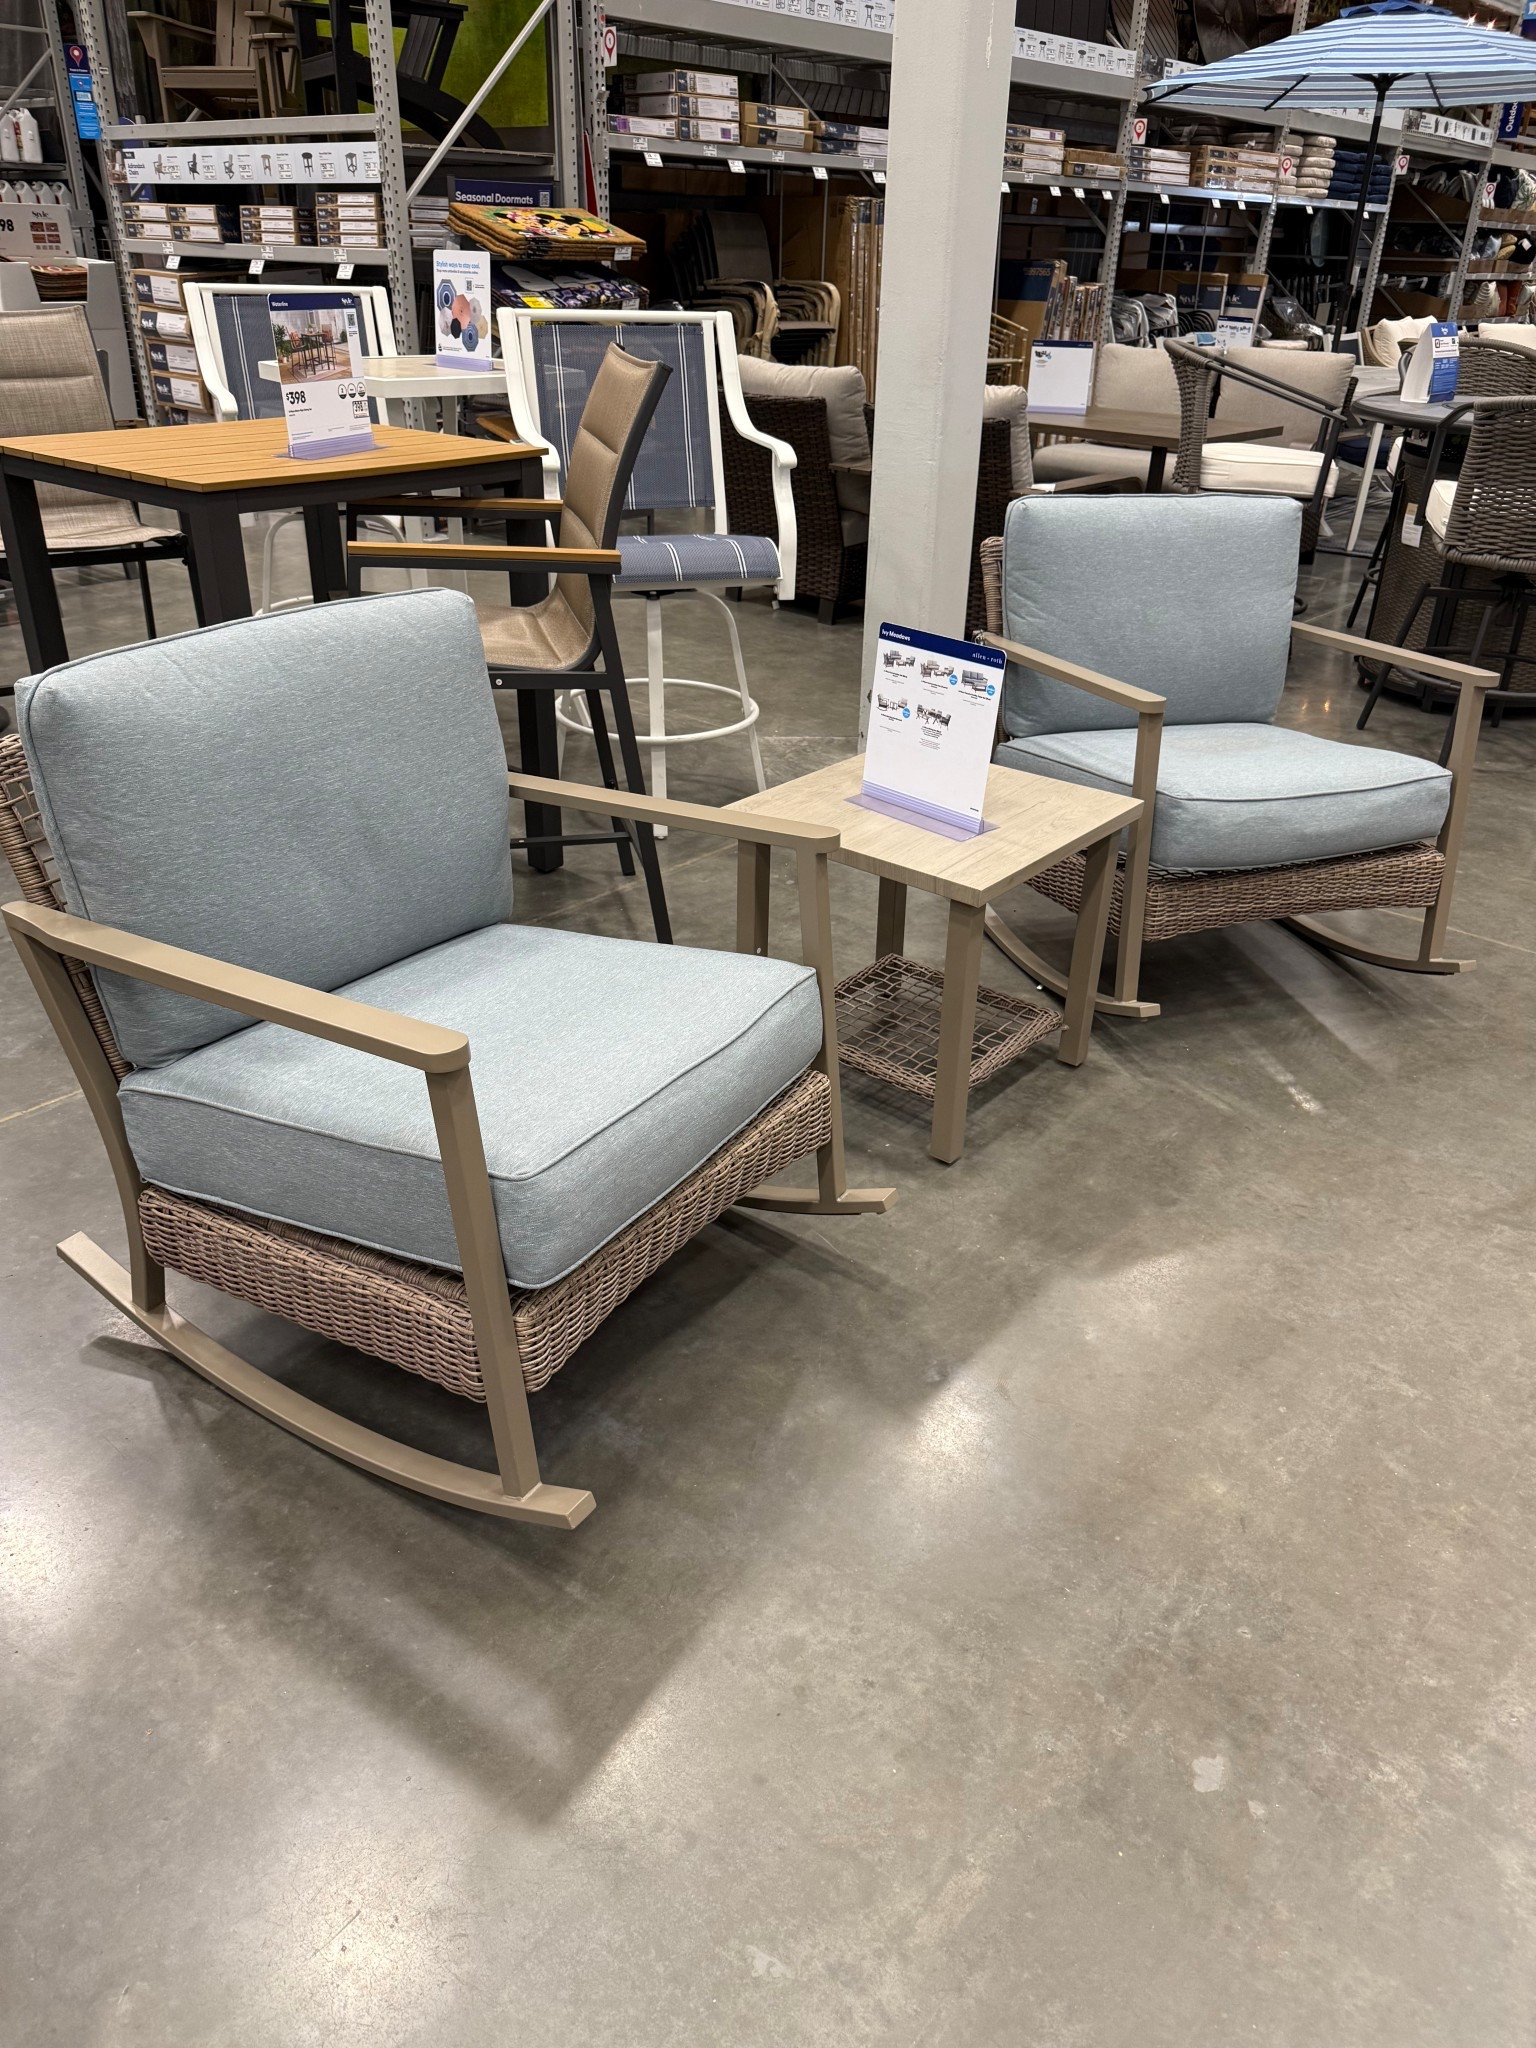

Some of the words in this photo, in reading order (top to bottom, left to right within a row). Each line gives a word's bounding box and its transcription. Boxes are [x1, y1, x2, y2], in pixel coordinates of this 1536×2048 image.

[455, 191, 494, 203] Seasonal
[495, 194, 534, 205] Doormats
[436, 260, 448, 268] Stylish
[285, 390, 307, 405] $398
[881, 628, 889, 637] Ivy
[889, 630, 911, 642] Meadows
[972, 652, 986, 660] allen
[990, 657, 1003, 665] roth
